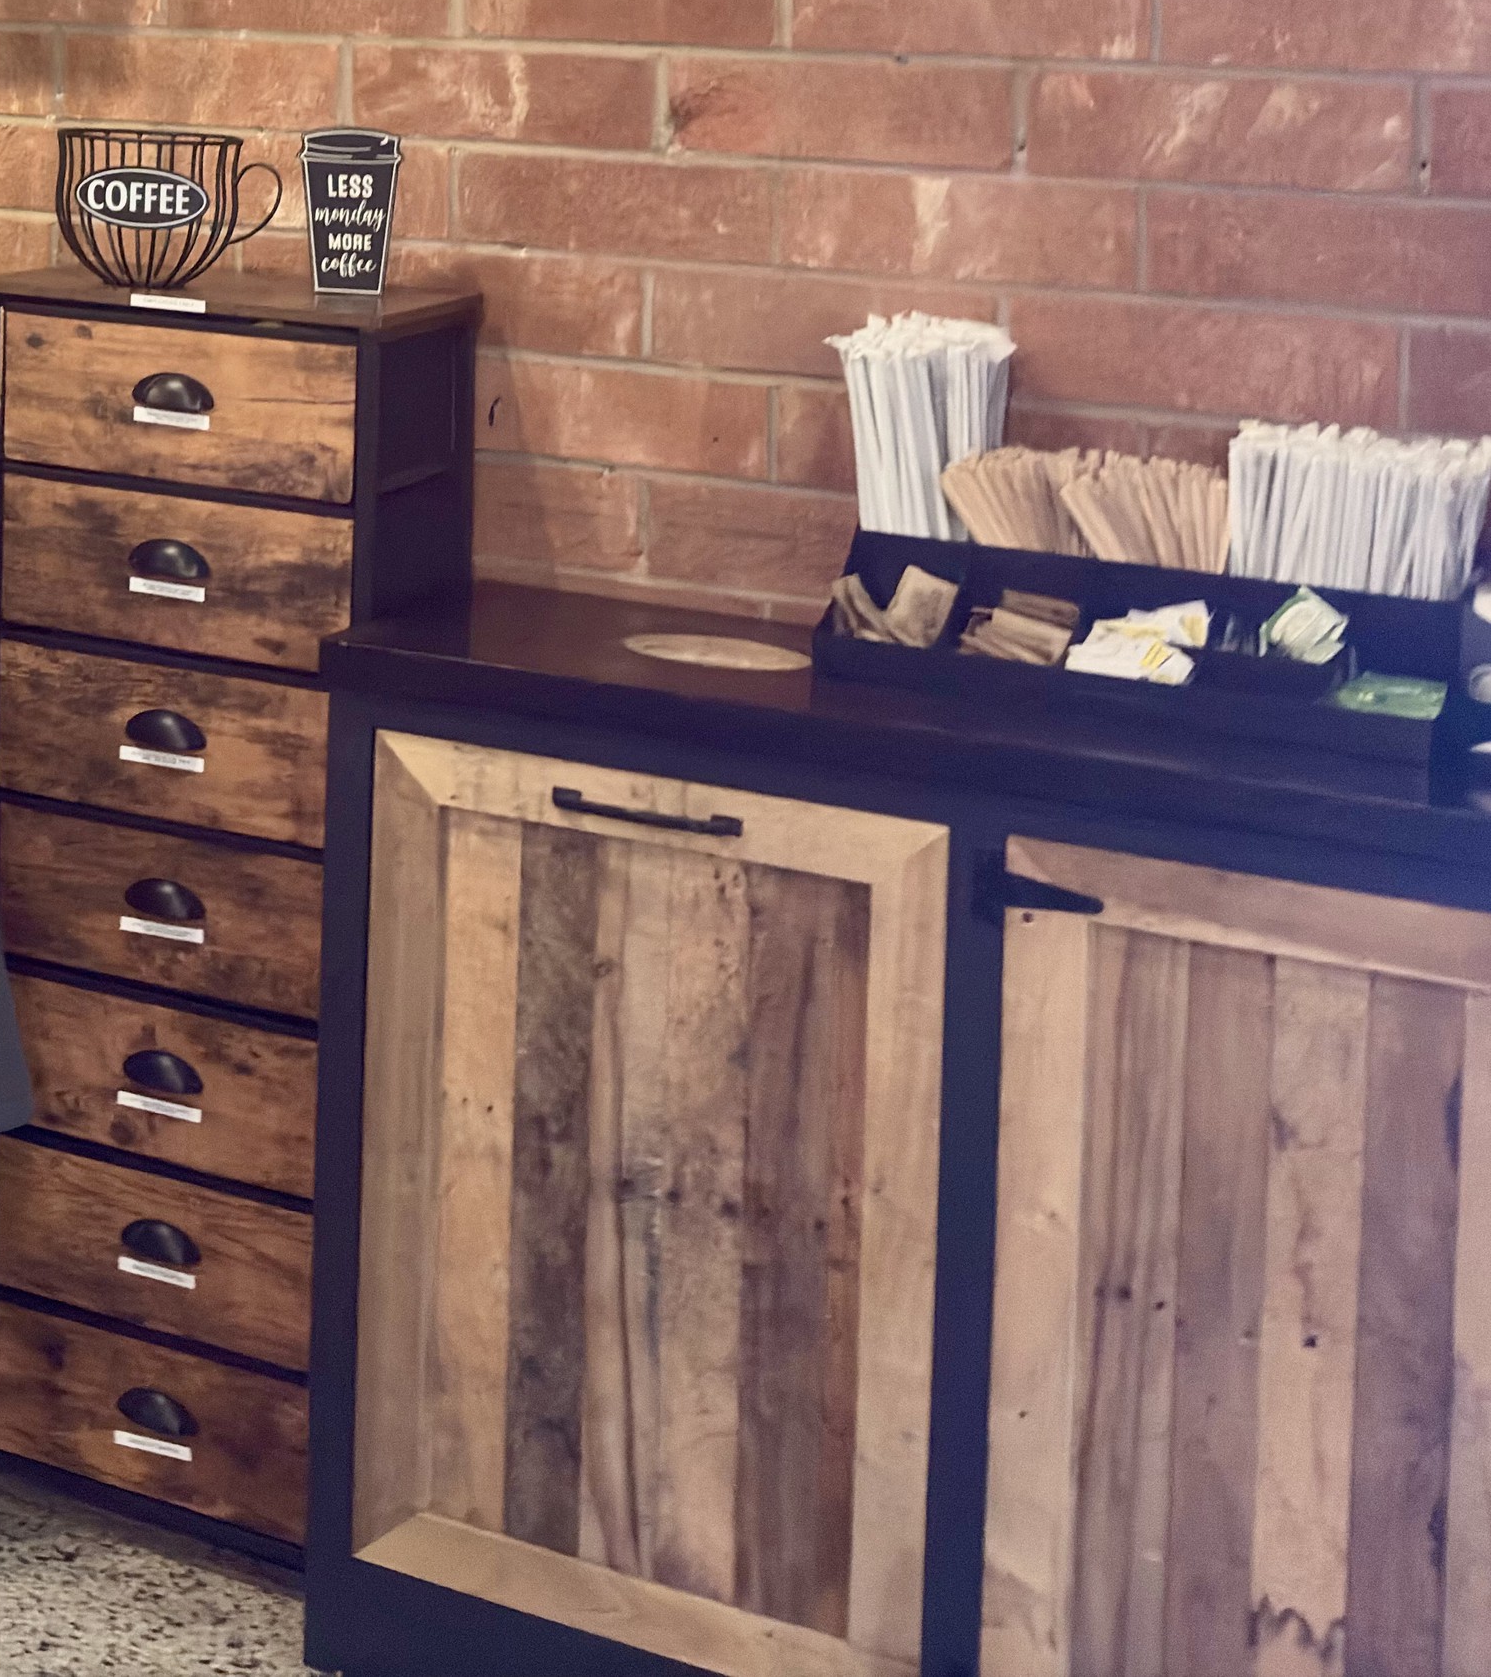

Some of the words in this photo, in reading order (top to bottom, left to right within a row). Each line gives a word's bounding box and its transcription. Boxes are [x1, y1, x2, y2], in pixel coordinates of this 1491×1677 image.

[86, 178, 190, 216] COFFEE
[327, 173, 374, 199] LESS
[314, 200, 386, 233] monday
[328, 234, 372, 252] MORE
[321, 254, 377, 279] coffee
